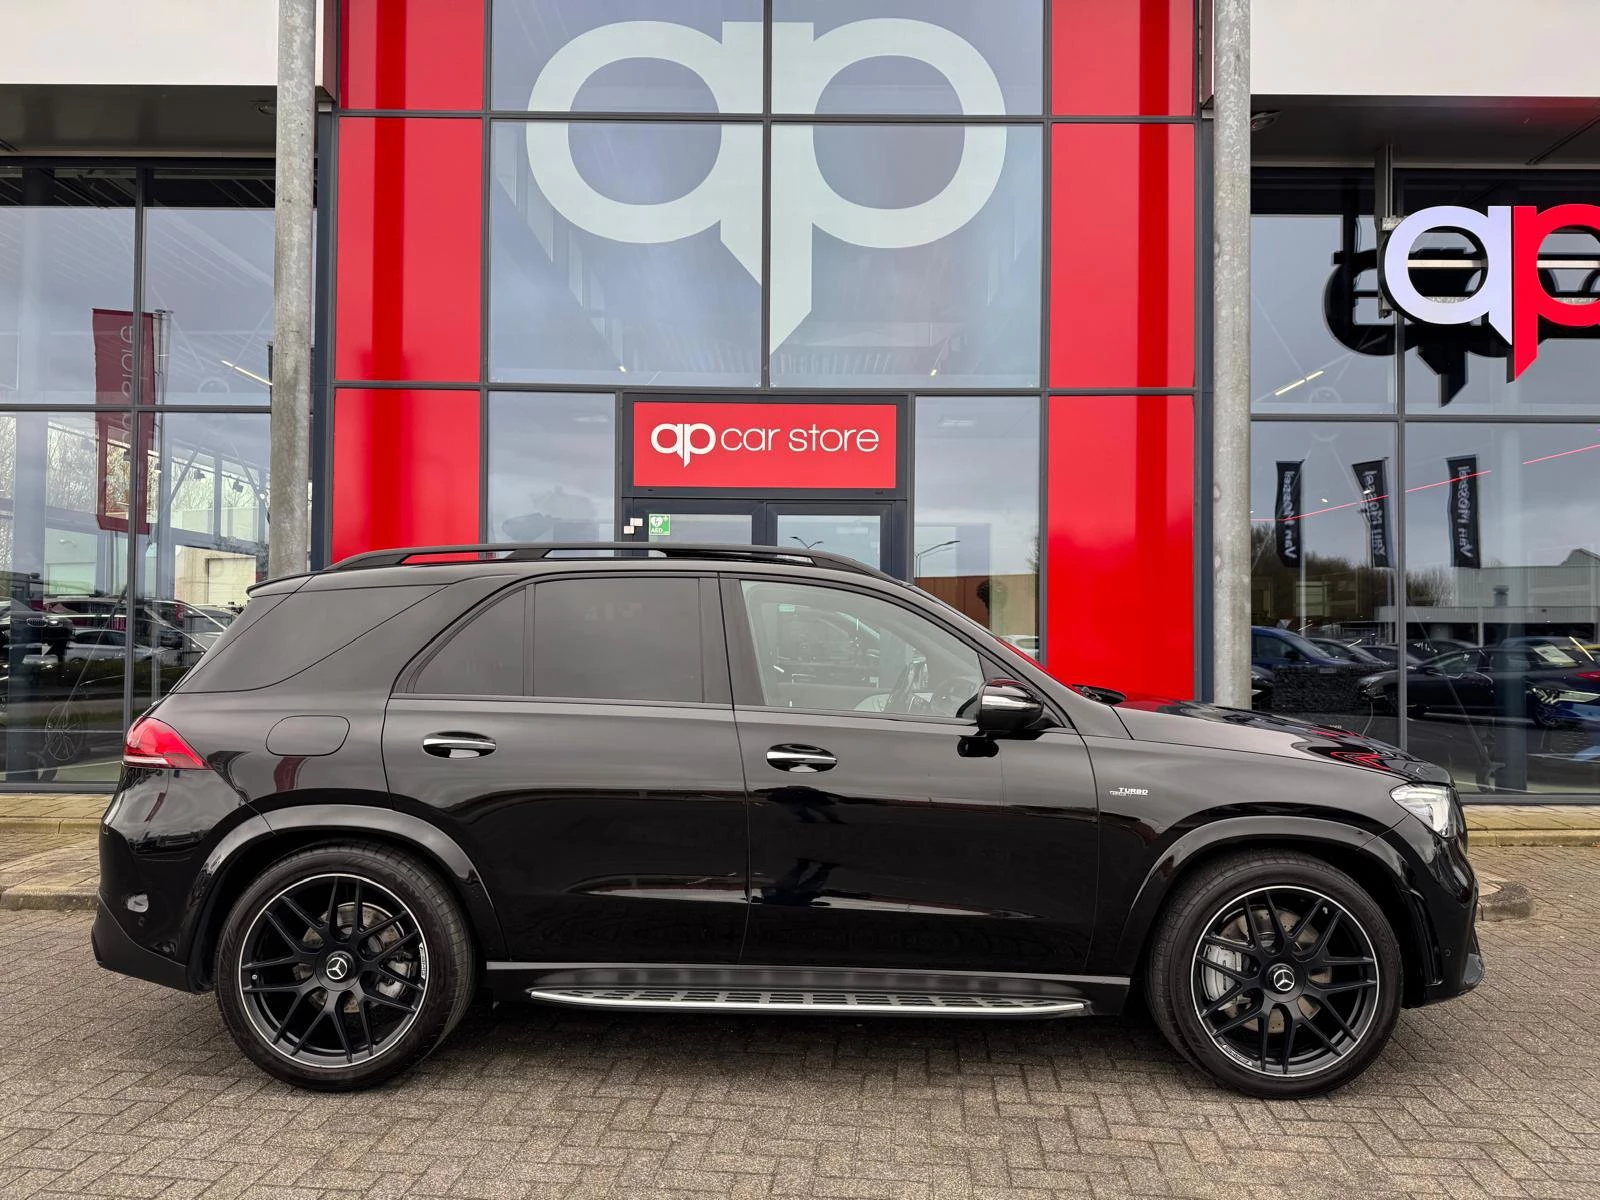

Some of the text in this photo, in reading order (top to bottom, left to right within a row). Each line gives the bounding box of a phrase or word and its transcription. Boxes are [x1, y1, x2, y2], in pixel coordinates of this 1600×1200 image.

[526, 18, 1007, 355] ap
[651, 423, 880, 468] ap car store
[1118, 787, 1149, 796] TURBO
